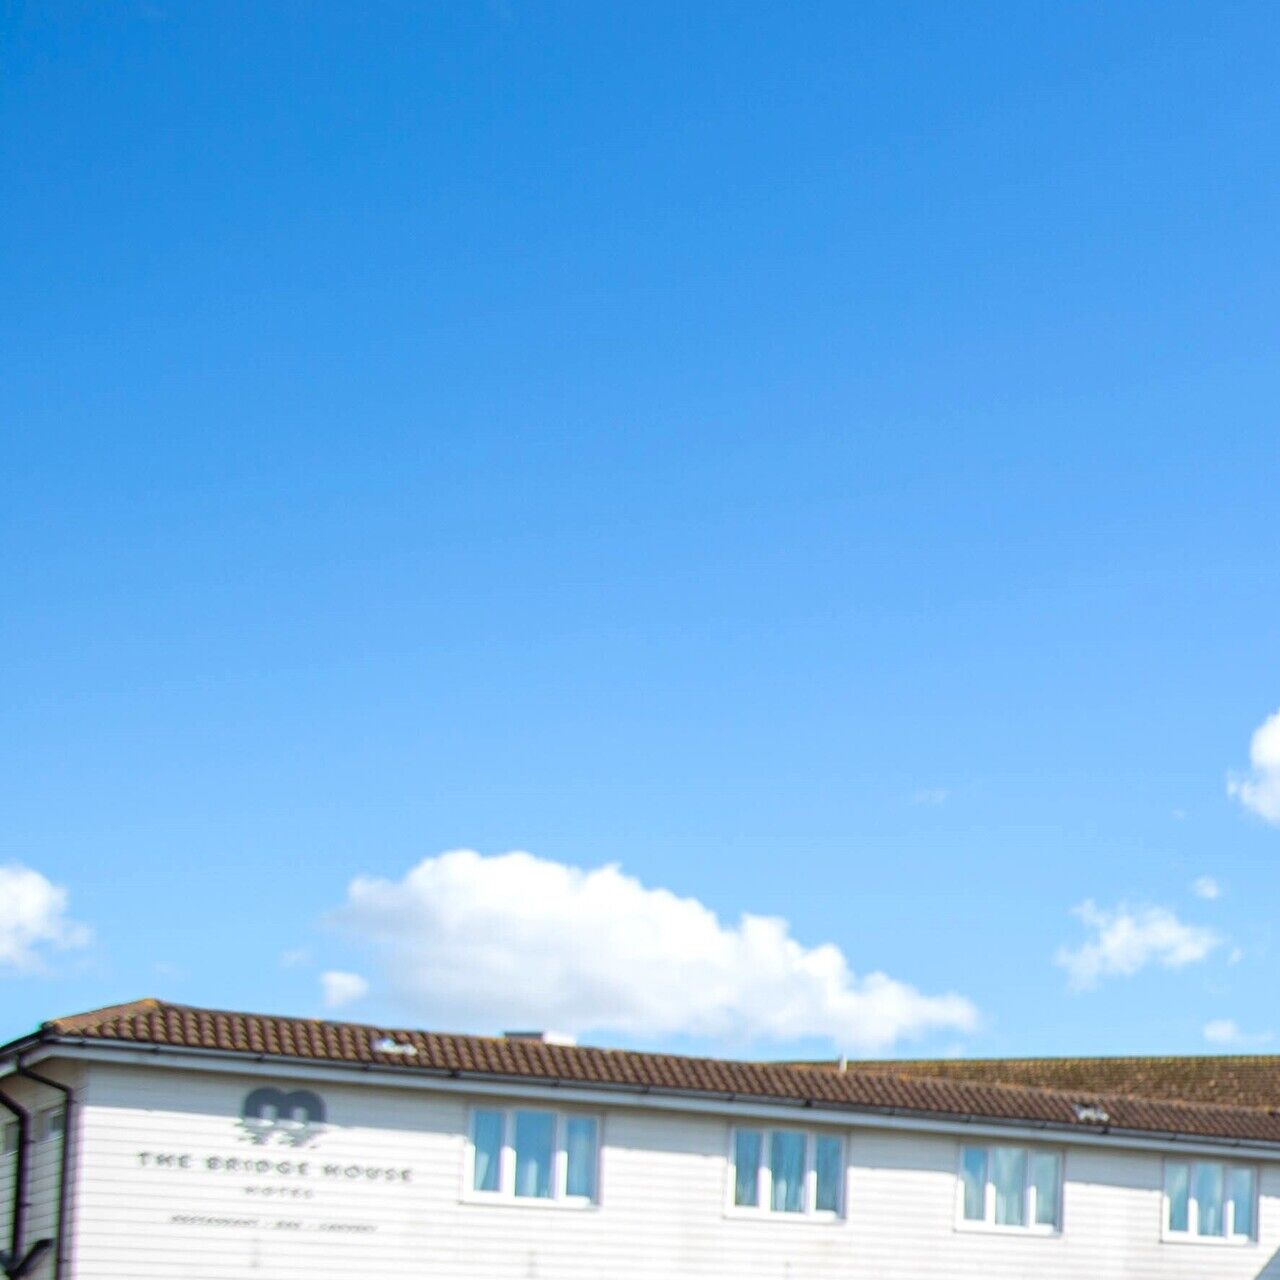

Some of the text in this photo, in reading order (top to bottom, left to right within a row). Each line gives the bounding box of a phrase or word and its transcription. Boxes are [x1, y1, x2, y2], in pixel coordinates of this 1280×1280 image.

[138, 1151, 412, 1182] THE BRIDGE HOUSE
